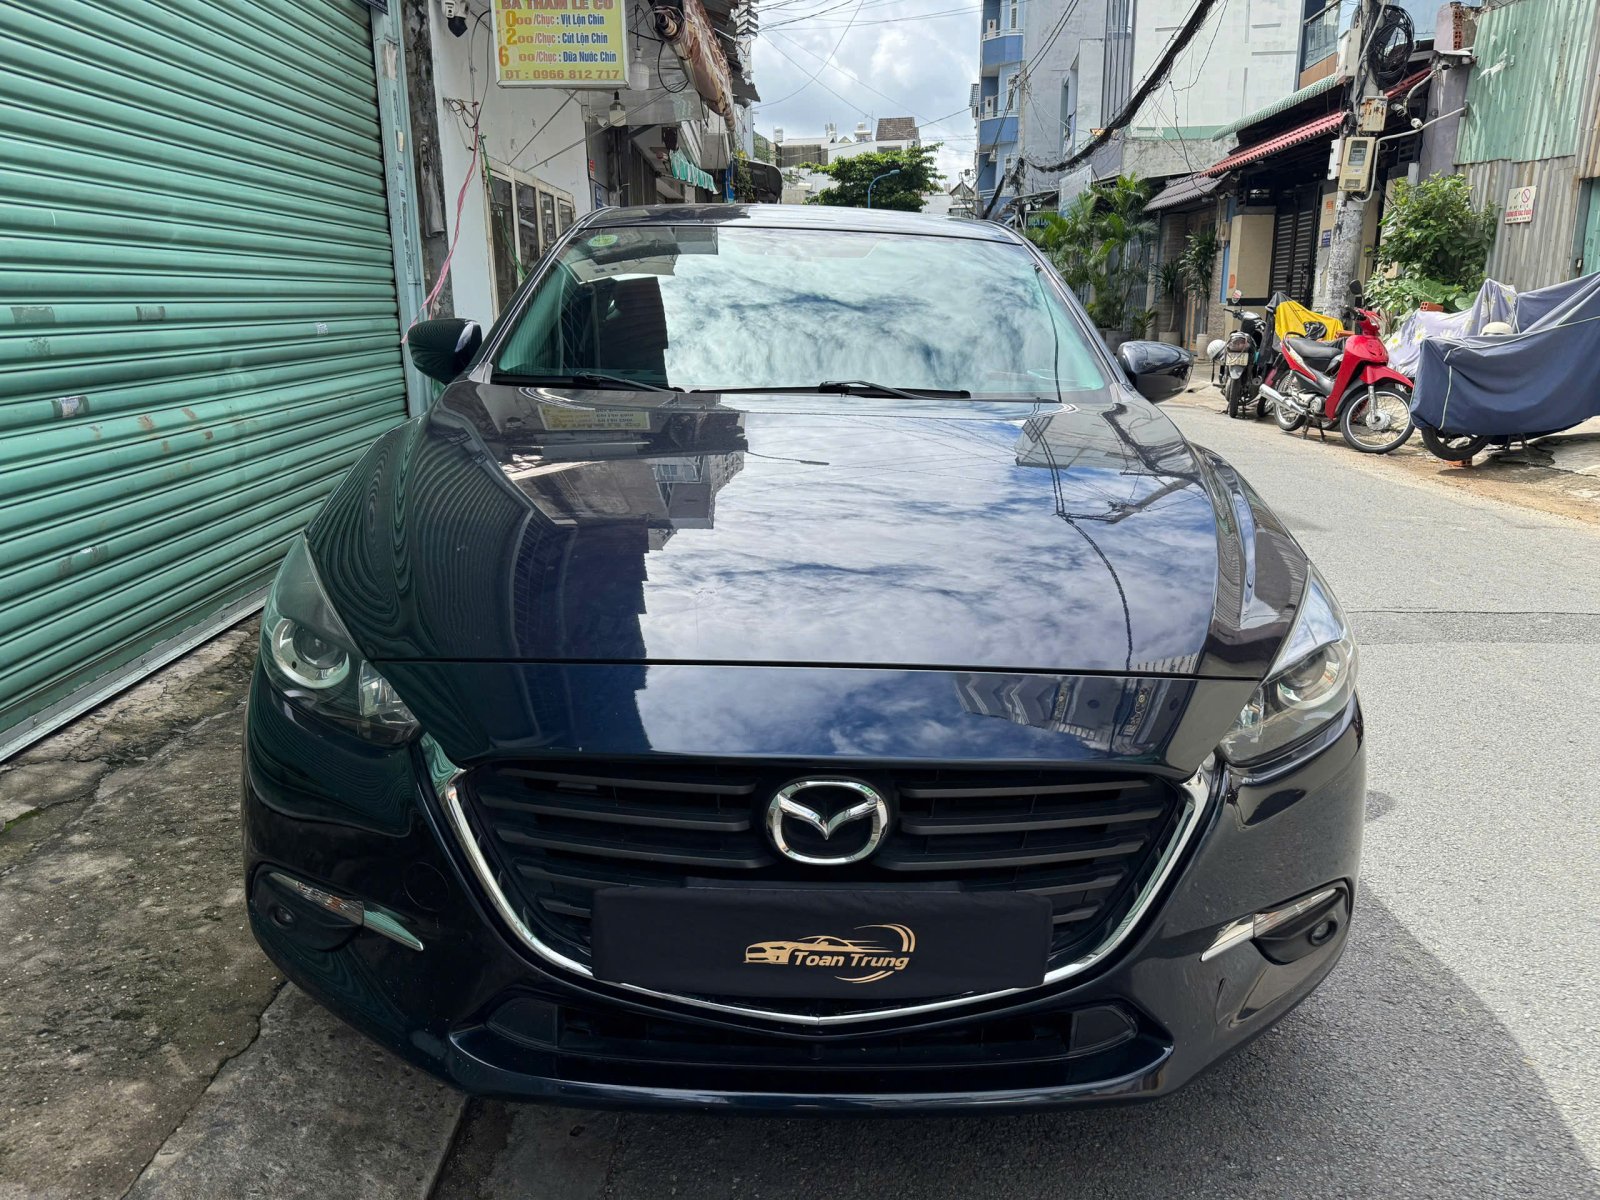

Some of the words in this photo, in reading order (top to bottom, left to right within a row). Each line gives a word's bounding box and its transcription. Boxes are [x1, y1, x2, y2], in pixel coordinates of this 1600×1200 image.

[560, 13, 571, 28] Vịt
[532, 69, 565, 80] 0966
[568, 69, 593, 80] 812
[595, 69, 620, 80] 717
[794, 951, 845, 967] Toan
[849, 953, 910, 971] Trung
